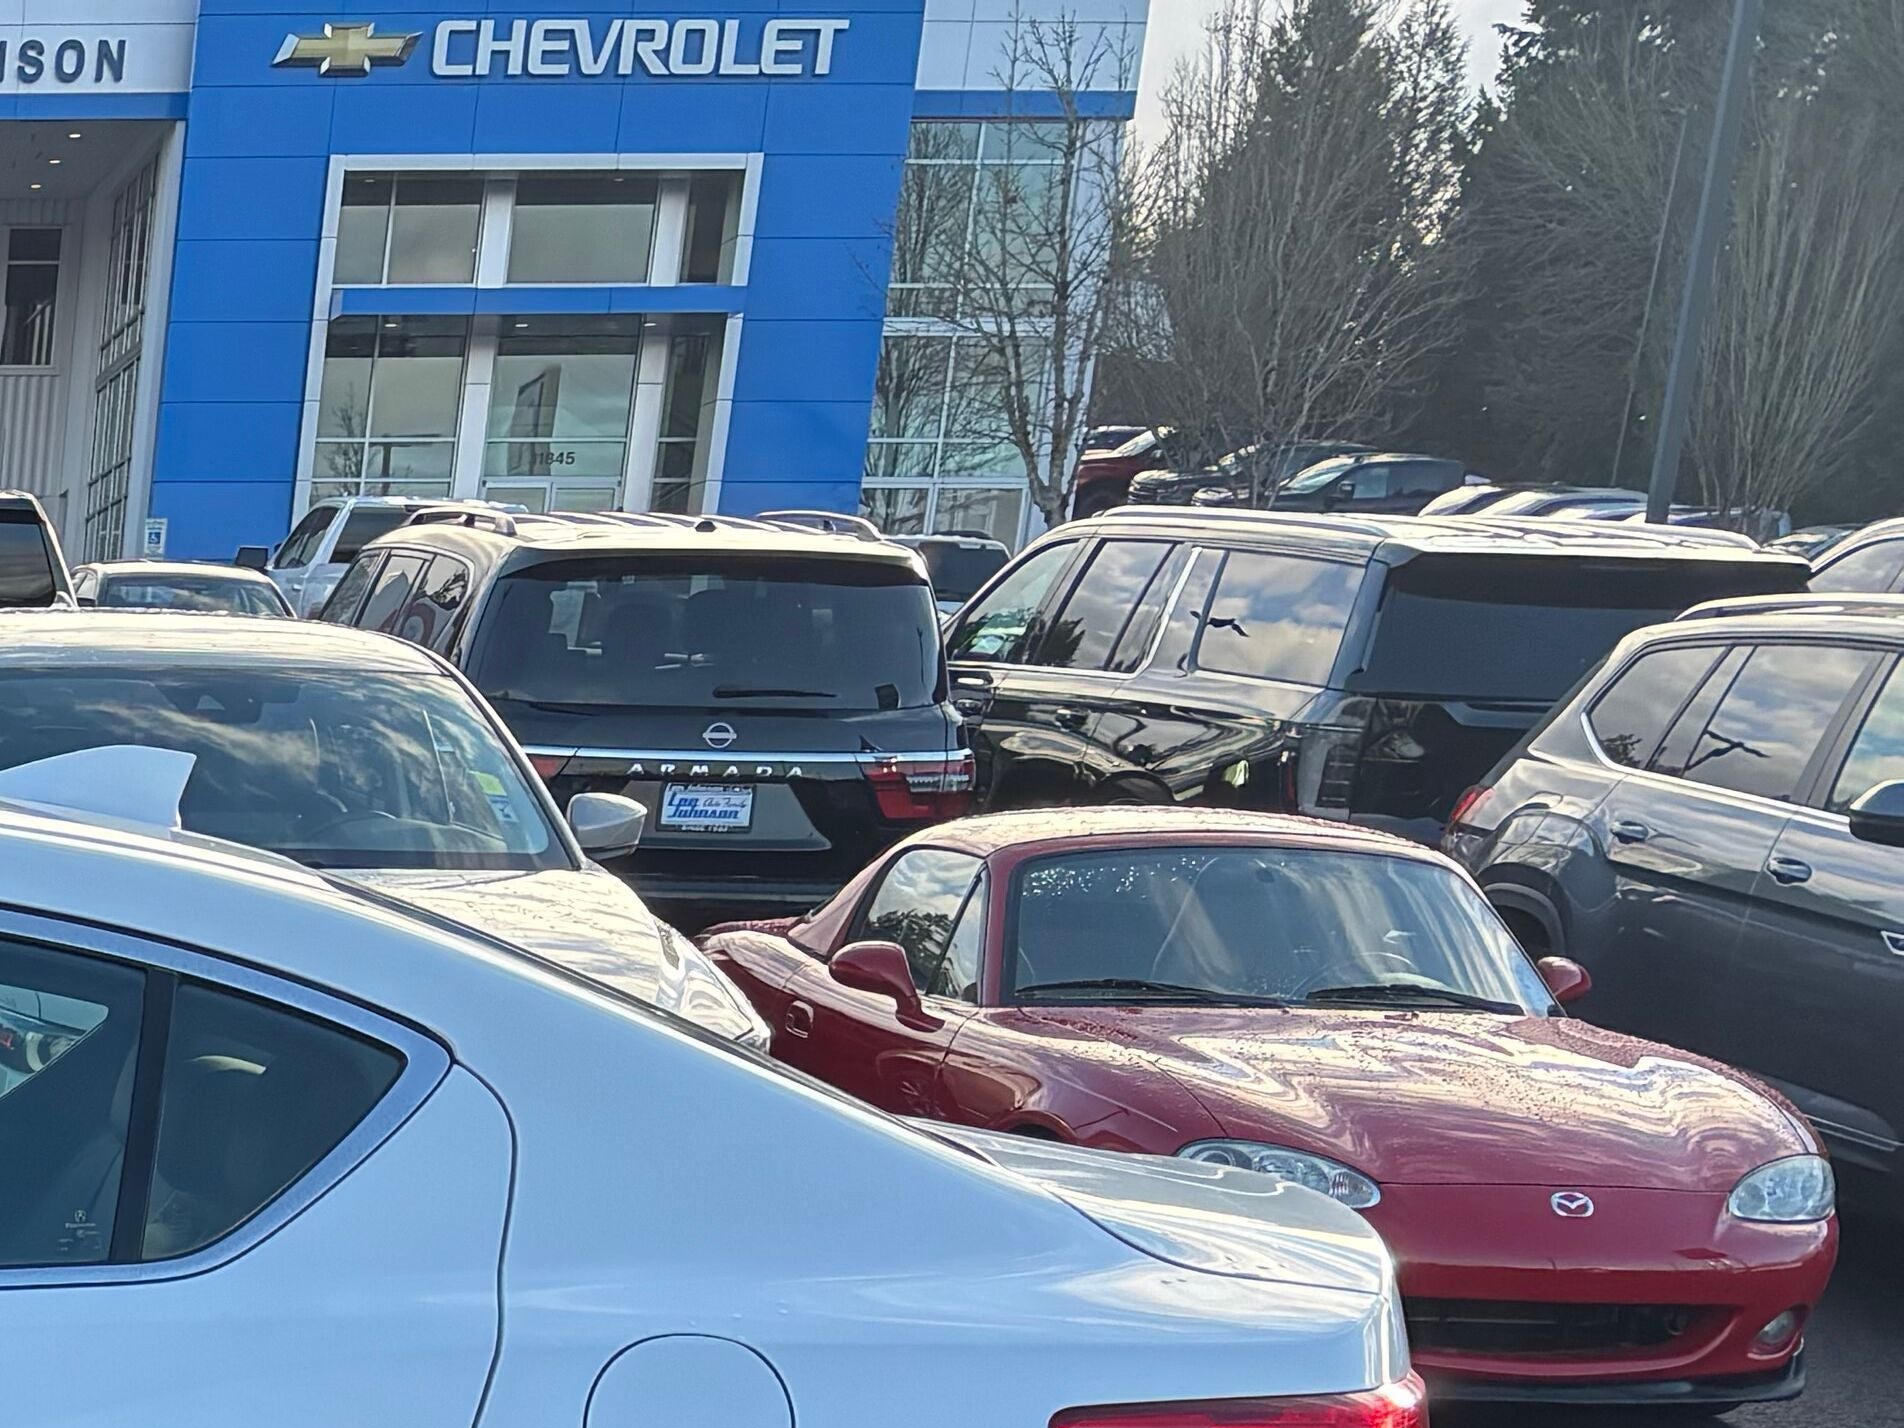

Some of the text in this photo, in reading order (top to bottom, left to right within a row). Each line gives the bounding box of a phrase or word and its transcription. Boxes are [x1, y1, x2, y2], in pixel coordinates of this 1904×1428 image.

[432, 18, 850, 76] CHEVROLET
[626, 763, 803, 778] ARMADA
[667, 791, 699, 807] Lee
[667, 806, 739, 819] Johnson
